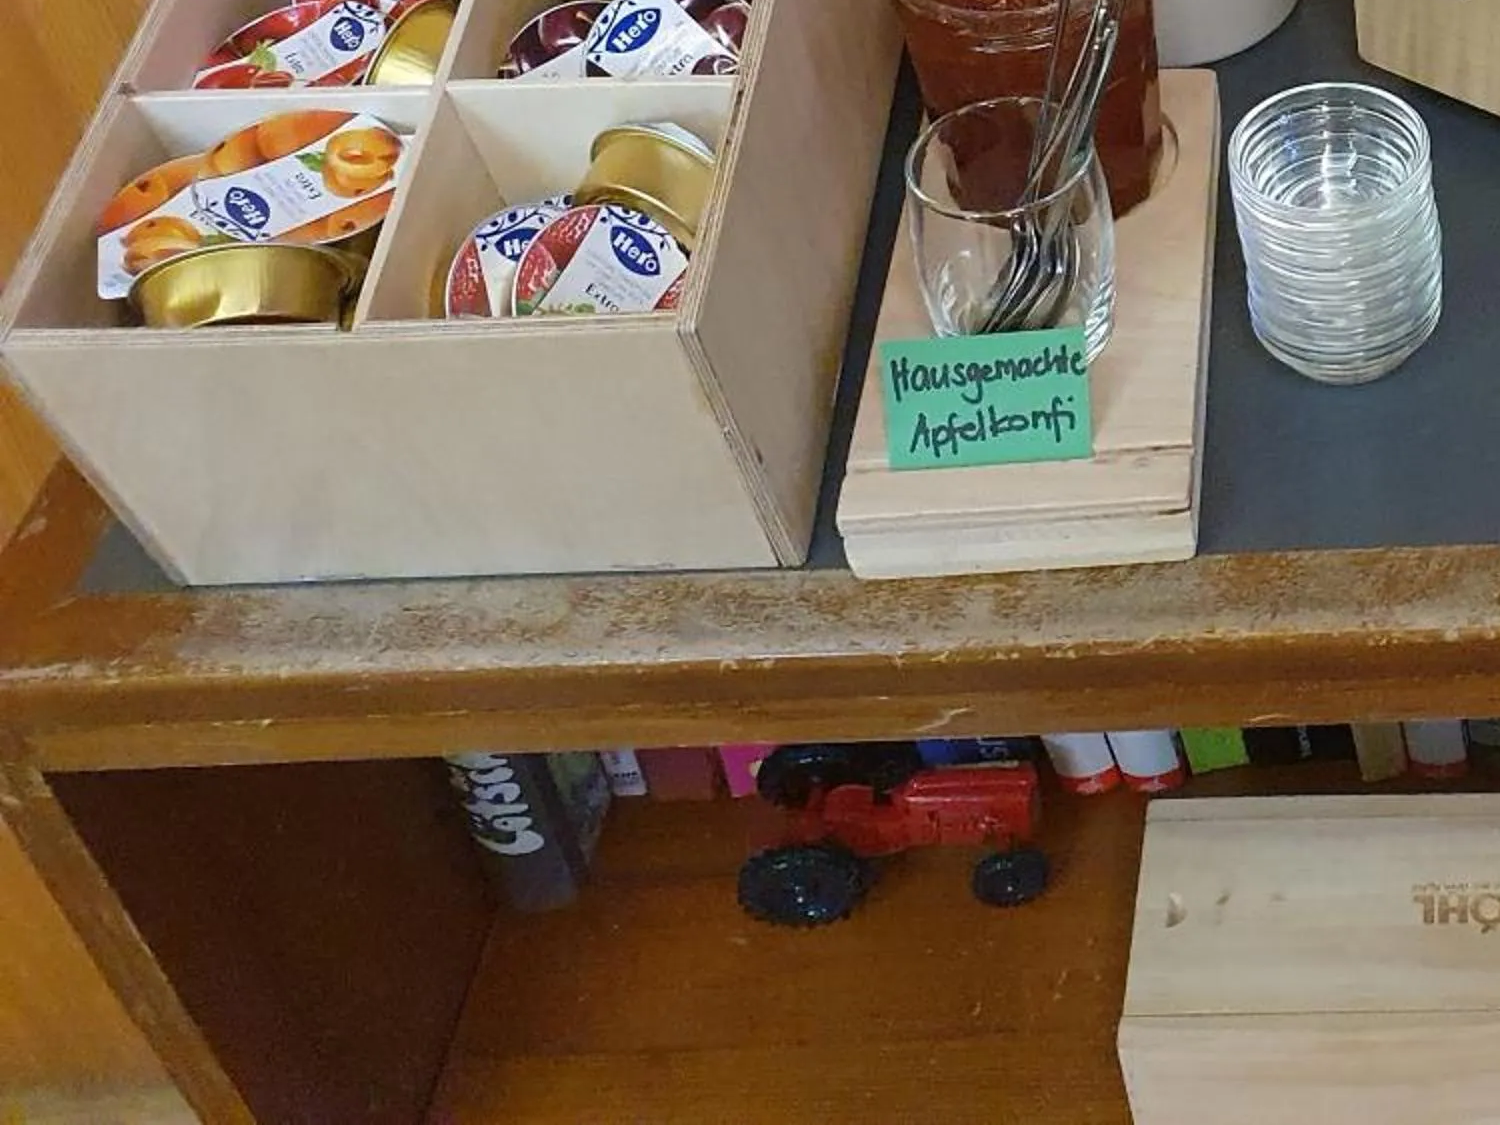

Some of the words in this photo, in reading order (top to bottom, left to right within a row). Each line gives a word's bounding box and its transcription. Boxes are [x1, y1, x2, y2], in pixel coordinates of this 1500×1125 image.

[333, 19, 364, 49] Hero
[611, 10, 658, 52] Hero
[662, 52, 695, 76] xtra
[228, 189, 267, 227] Hero
[504, 239, 530, 258] He
[613, 232, 659, 273] Hero
[584, 283, 619, 313] Extra
[889, 343, 1088, 405] Hausgemachte
[909, 395, 1076, 458] Apfelkonfi
